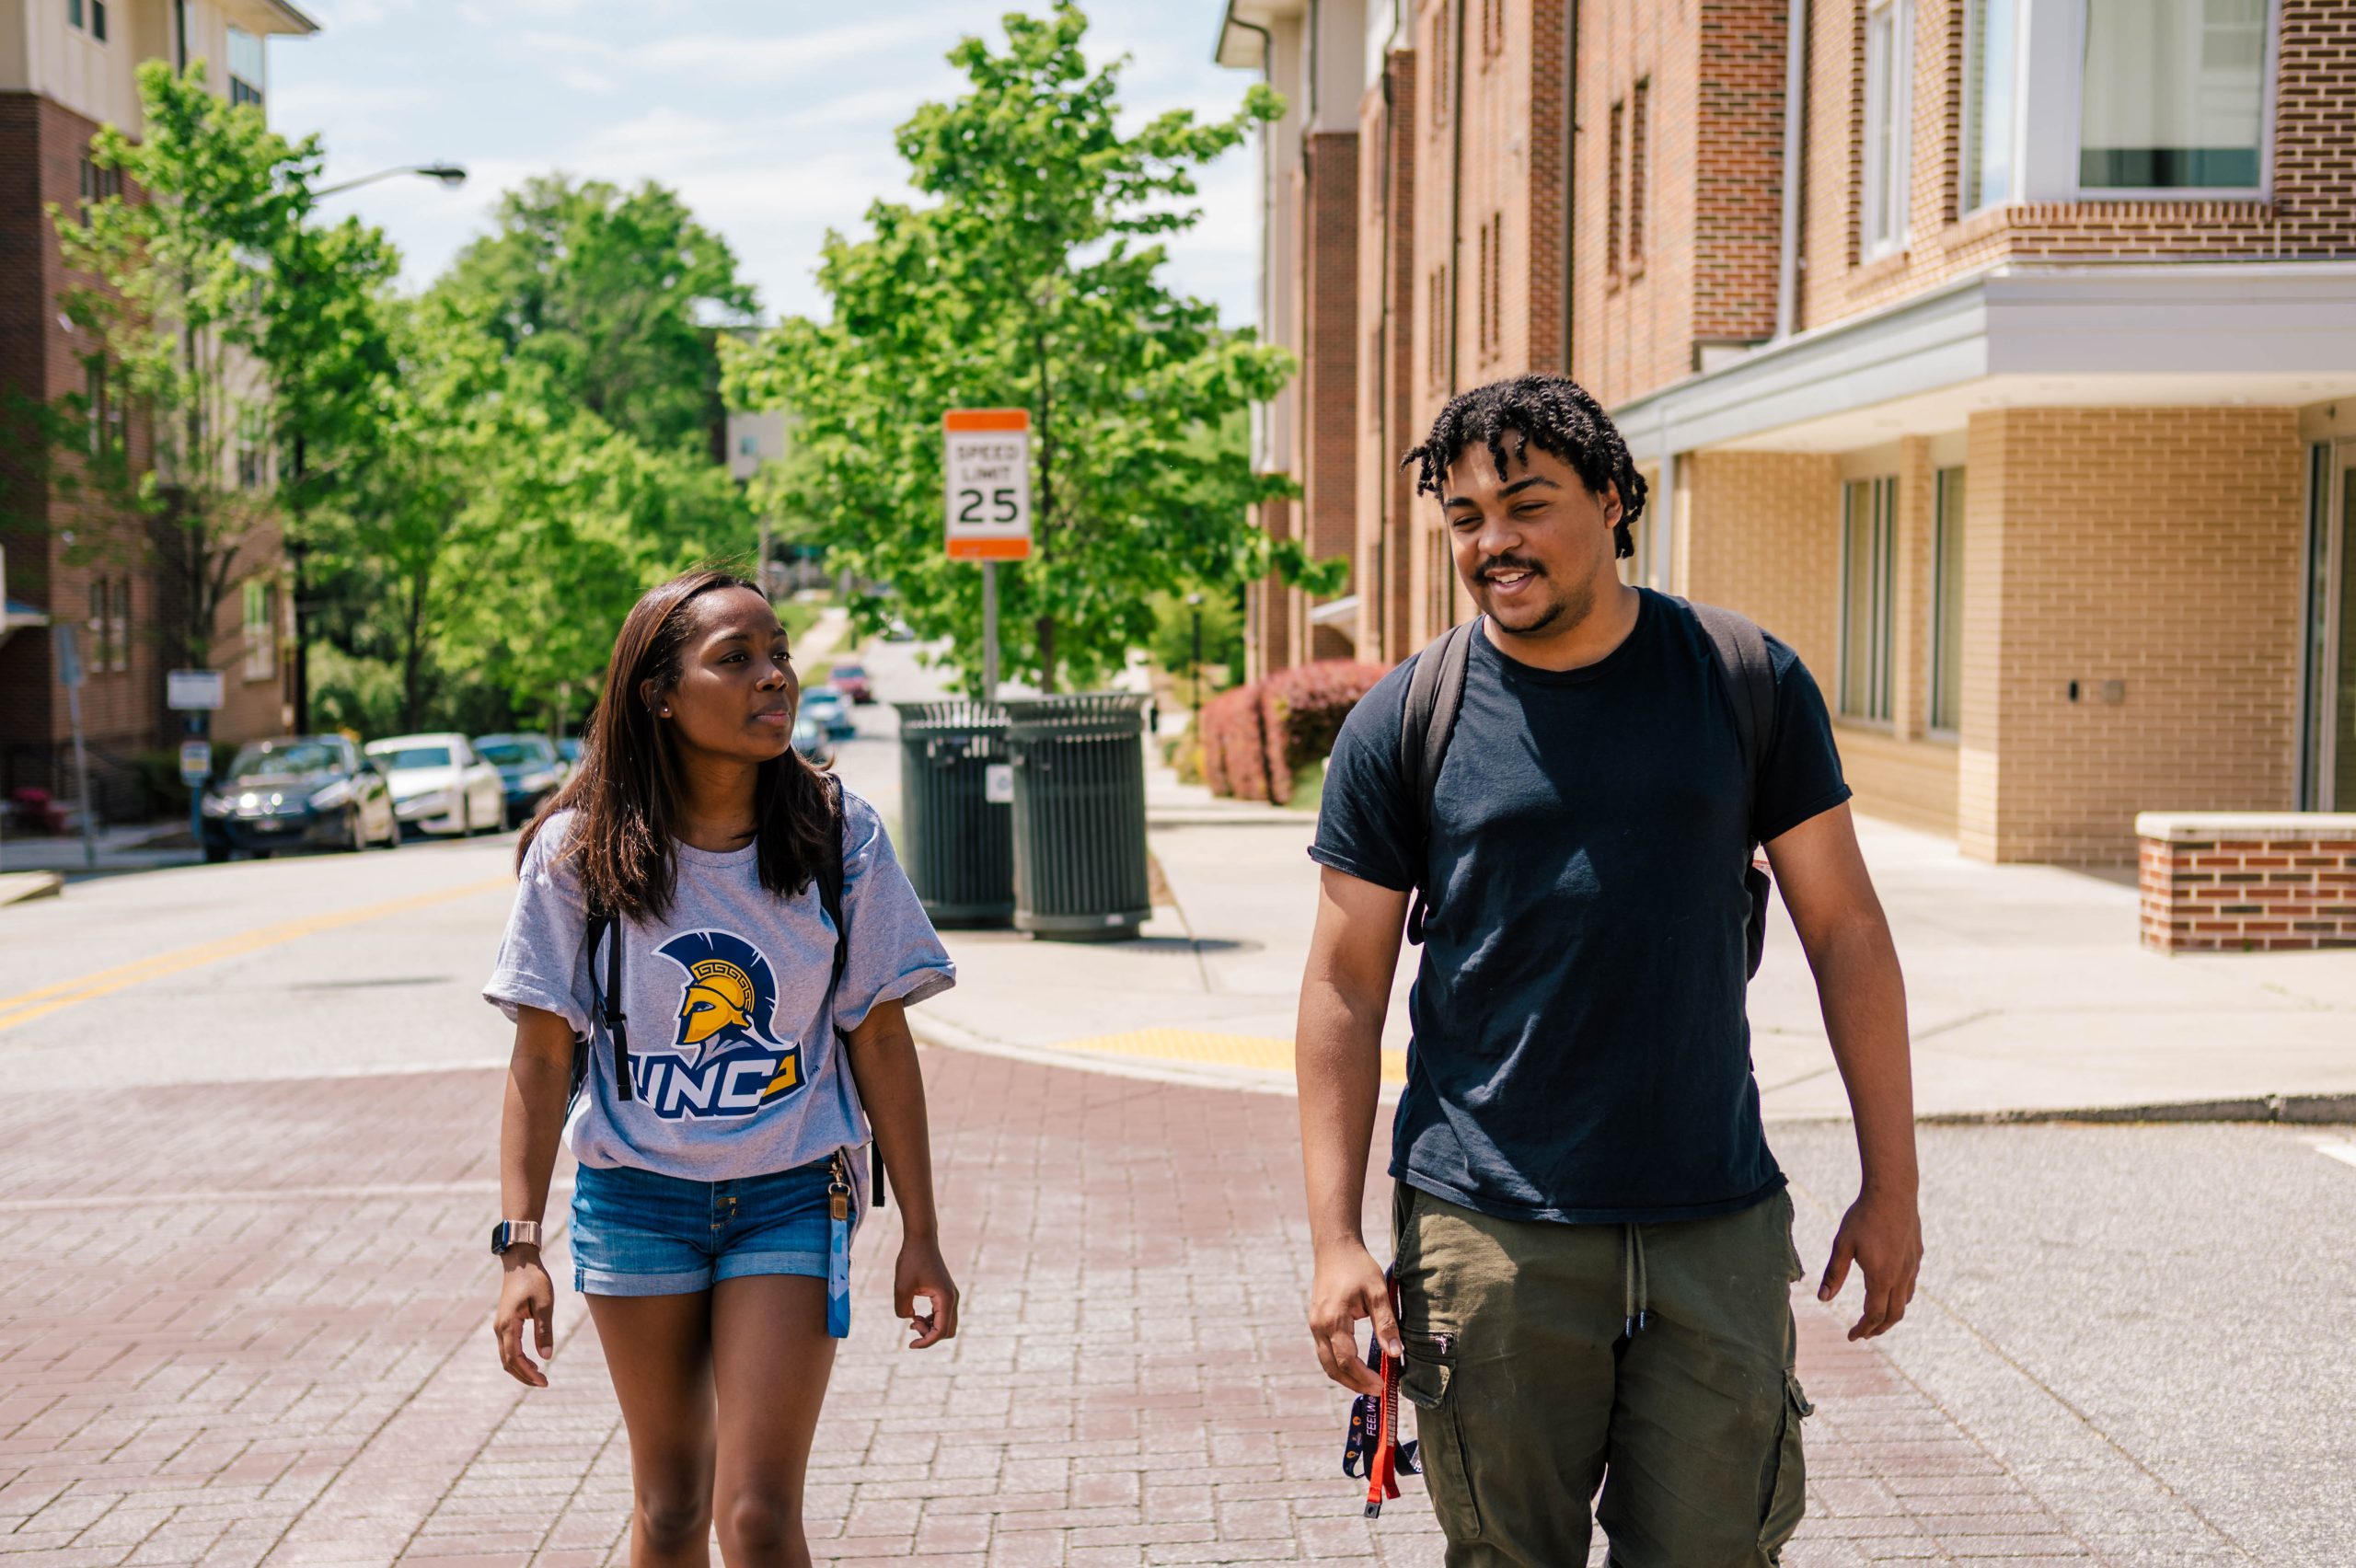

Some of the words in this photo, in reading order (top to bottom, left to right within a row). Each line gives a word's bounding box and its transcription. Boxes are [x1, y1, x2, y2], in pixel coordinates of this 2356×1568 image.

[957, 444, 1019, 459] SPEED
[962, 467, 1011, 482] LIMIT
[959, 489, 1019, 523] 25
